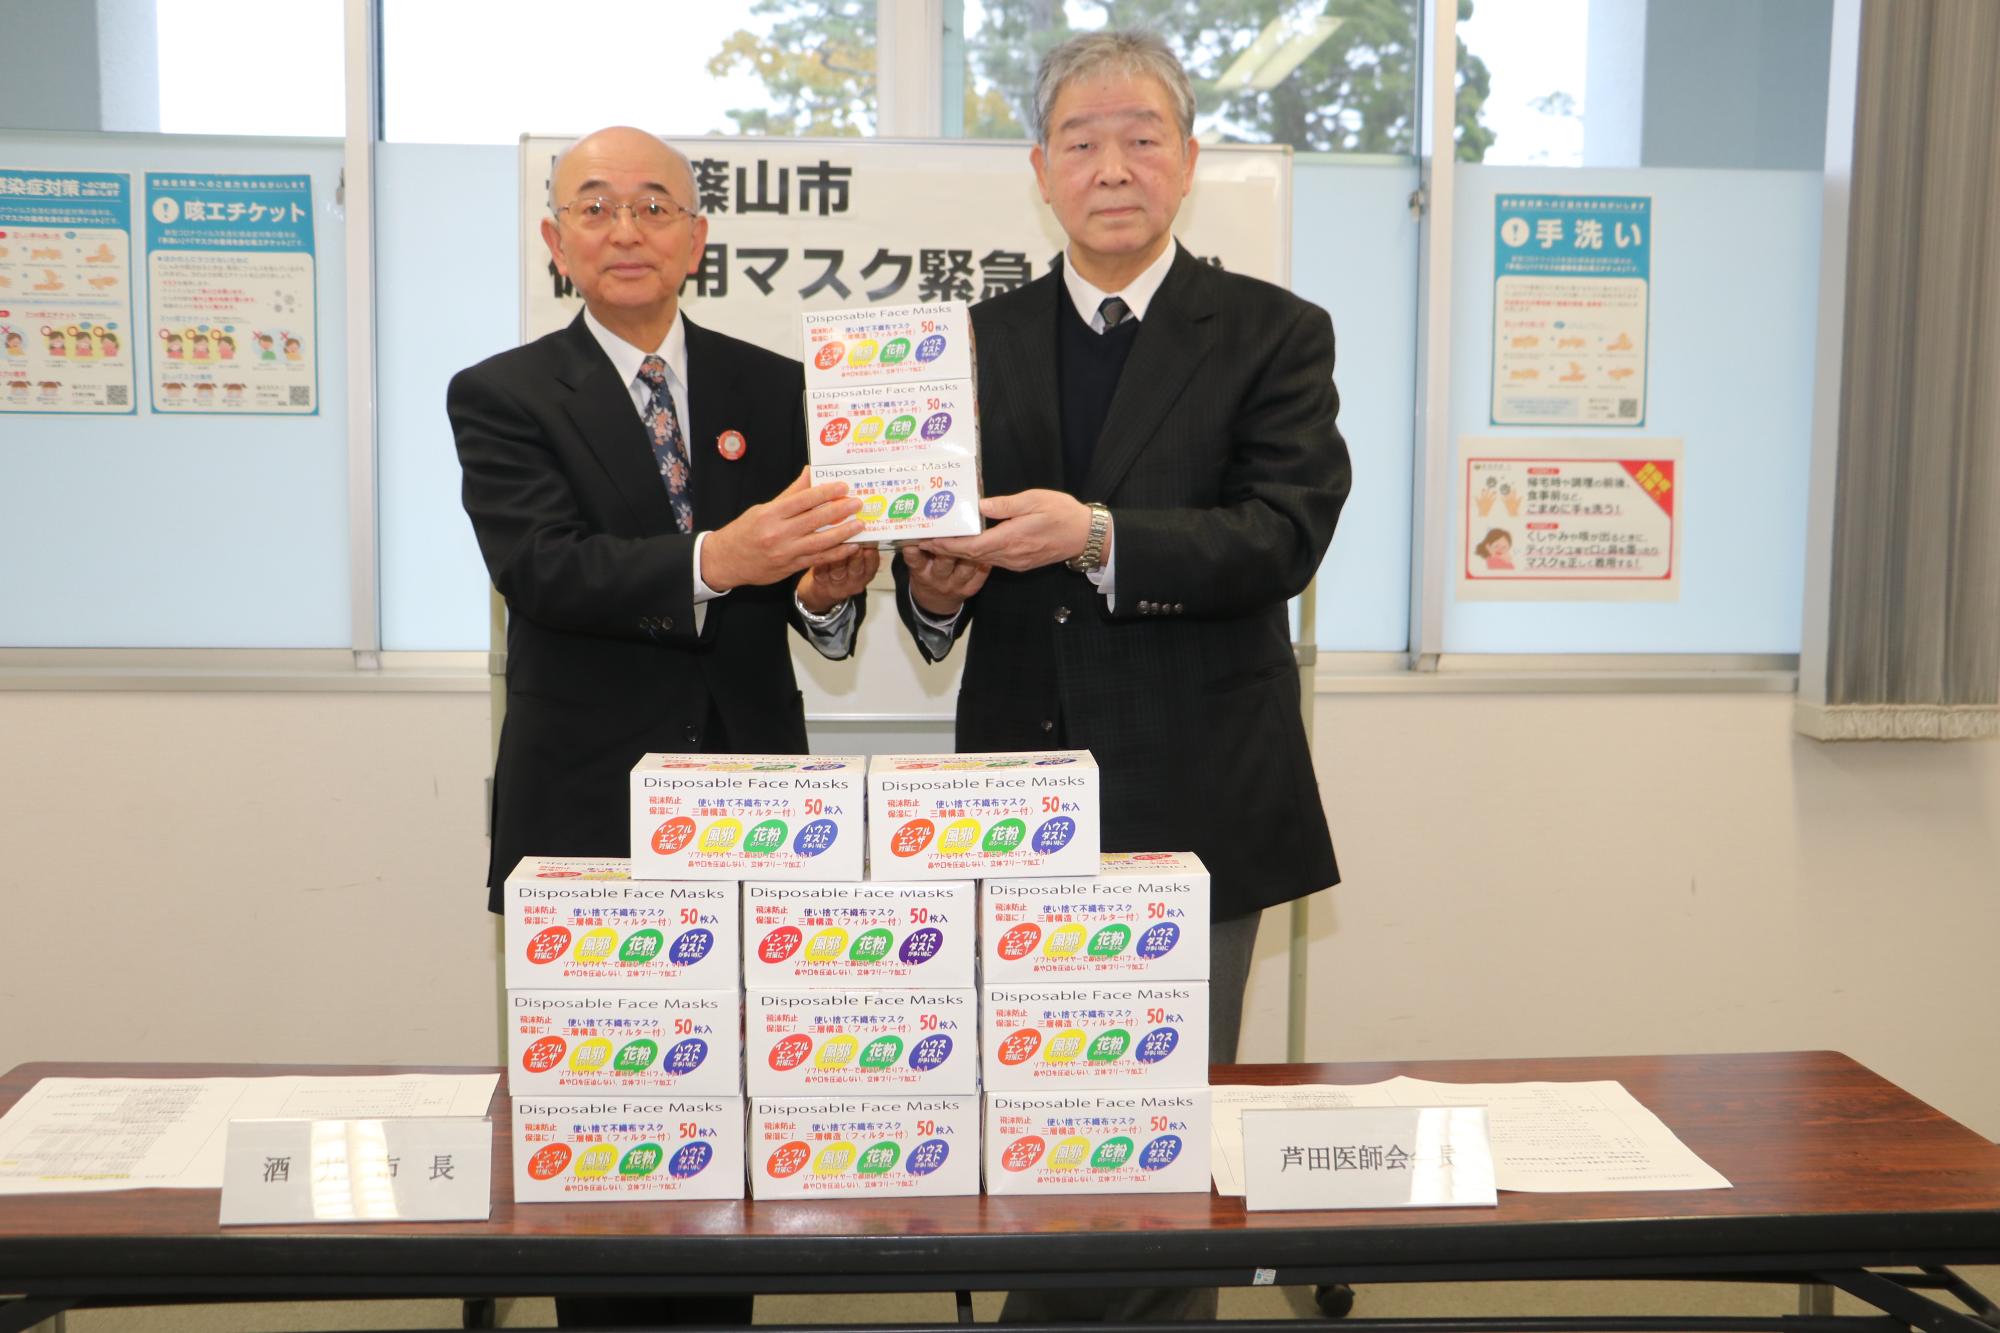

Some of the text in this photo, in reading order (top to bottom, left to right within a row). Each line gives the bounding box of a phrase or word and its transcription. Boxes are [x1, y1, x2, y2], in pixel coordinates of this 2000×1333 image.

[184, 201, 306, 224] 咳エチケット
[1535, 218, 1642, 250] 手洗い
[807, 305, 951, 325] Disposable Face Masks
[813, 383, 957, 401] Disposable Face Masks
[815, 461, 960, 480] Disposable Face Masks
[645, 778, 848, 790] Disposable Face Masks
[882, 775, 1085, 794] Disposable Face Masks
[806, 824, 831, 833] ハウス
[1043, 821, 1069, 831] ハウス
[754, 827, 780, 841] 花粉
[804, 834, 828, 842] ダスト
[992, 826, 1019, 841] 花粉
[1042, 830, 1066, 840] ダスト
[520, 888, 724, 900] Disposable Face Masks
[751, 887, 953, 900] Disposable Face Masks
[991, 883, 1190, 898] Disposable Face Masks
[911, 933, 936, 942] ハウス
[1148, 927, 1173, 936] ハウス
[629, 936, 656, 950] 花粉
[681, 934, 707, 942] ハウス
[859, 936, 886, 950] 花粉
[1098, 931, 1124, 945] 花粉
[1147, 936, 1171, 945] ダスト
[680, 943, 704, 951] ダスト
[909, 942, 934, 950] ダスト
[762, 995, 963, 1008] Disposable Face Masks
[992, 989, 1189, 1004] Disposable Face Masks
[515, 998, 718, 1010] Disposable Face Masks
[1147, 1032, 1172, 1041] ハウス
[675, 1044, 701, 1052] ハウス
[921, 1039, 946, 1048] ハウス
[1097, 1036, 1123, 1050] 花粉
[1146, 1041, 1169, 1050] ダスト
[624, 1046, 651, 1060] 花粉
[870, 1042, 896, 1057] 花粉
[919, 1048, 943, 1057] ダスト
[674, 1053, 698, 1061] ダスト
[520, 1102, 722, 1118] Disposable Face Masks
[759, 1100, 959, 1117] Disposable Face Masks
[996, 1097, 1193, 1111] Disposable Face Masks
[918, 1144, 942, 1153] ハウス
[1101, 1143, 1127, 1157] 花粉
[1151, 1140, 1175, 1148] ハウス
[680, 1146, 705, 1155] ハウス
[867, 1148, 893, 1162] 花粉
[1149, 1148, 1173, 1157] ダスト
[629, 1150, 656, 1165] 花粉
[679, 1155, 703, 1164] ダスト
[916, 1153, 940, 1162] ダスト
